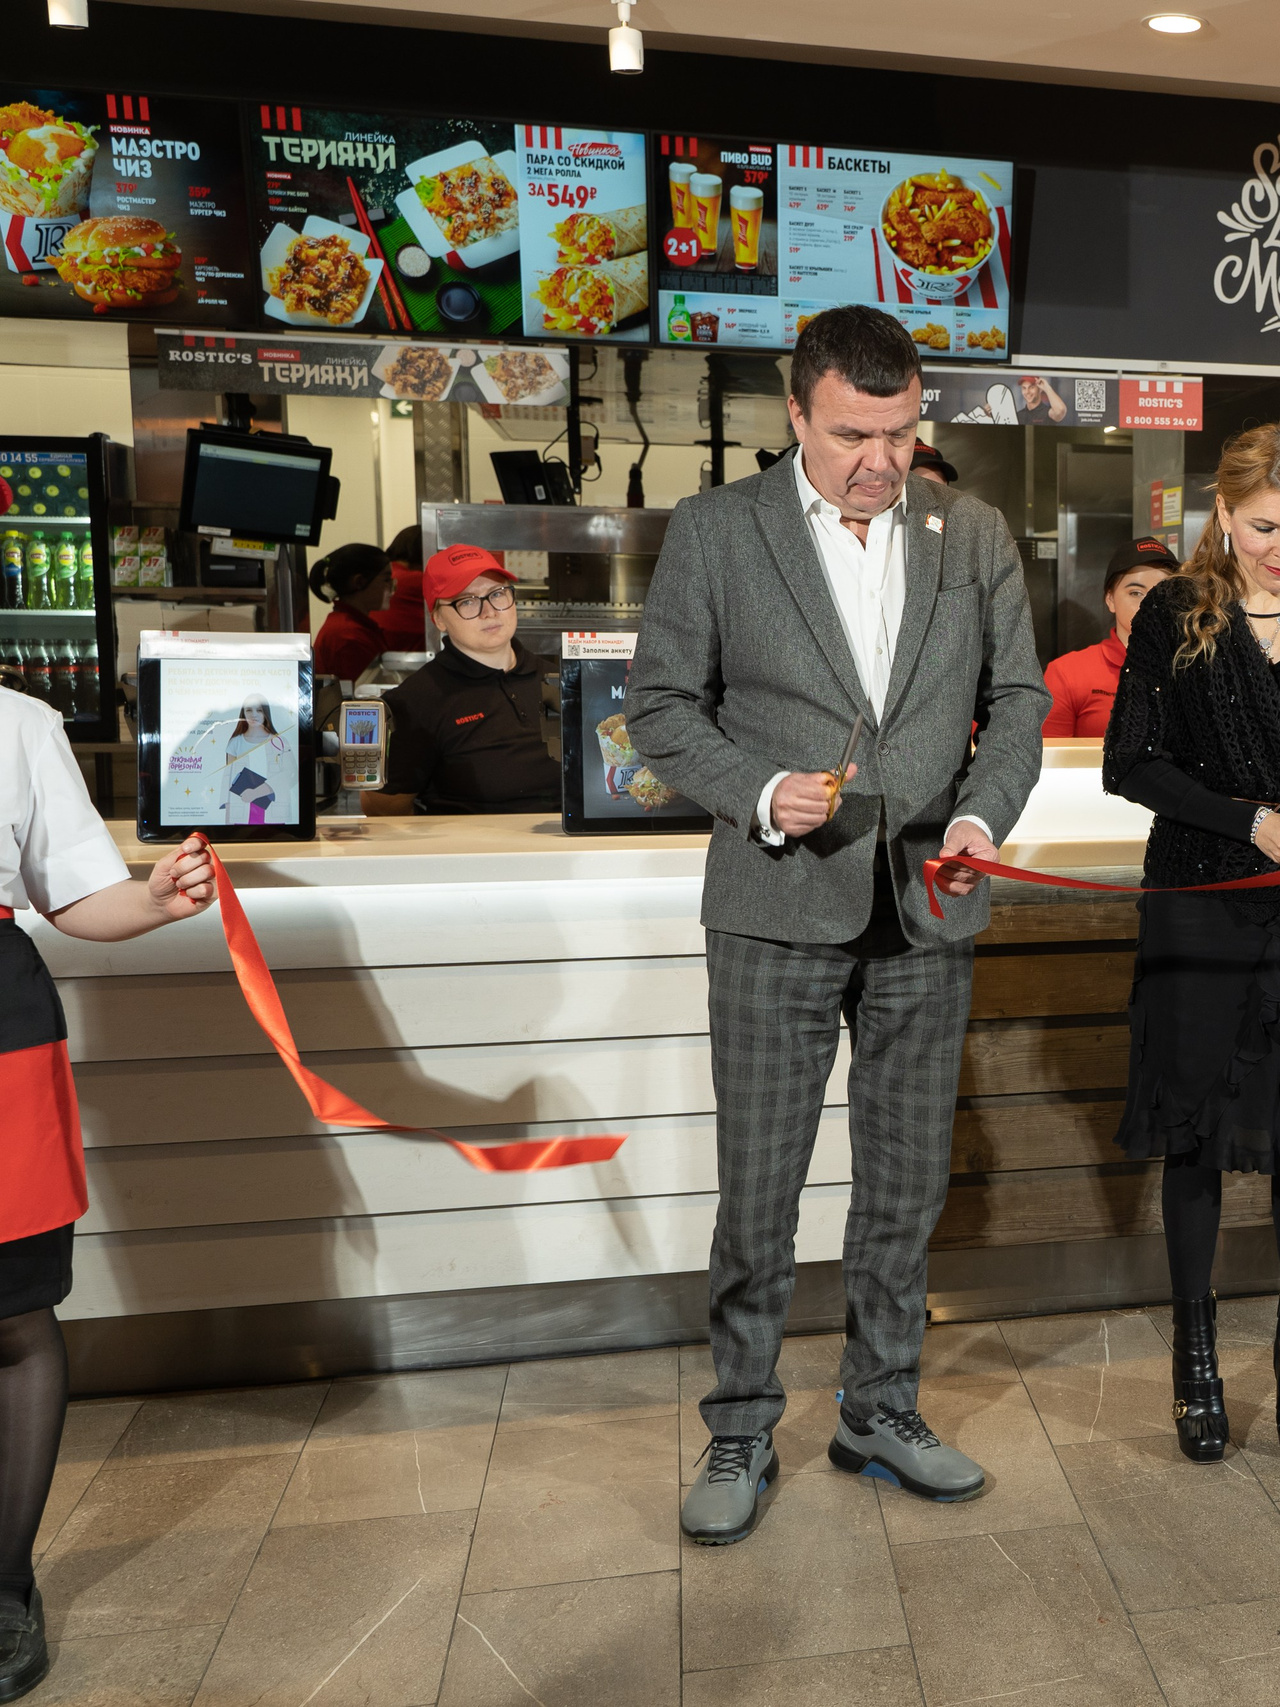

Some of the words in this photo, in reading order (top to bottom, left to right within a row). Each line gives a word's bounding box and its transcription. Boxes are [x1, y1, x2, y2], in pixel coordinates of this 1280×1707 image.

[110, 125, 151, 135] НОВИНКА
[344, 131, 396, 144] ЛИНЕЙКА
[111, 136, 201, 161] МАЭСТРО
[262, 135, 397, 174] ТЕРИЯКИ
[570, 142, 621, 156] Новинка
[526, 154, 554, 165] ПАРА
[557, 156, 571, 166] СО
[574, 156, 625, 170] СКИДКОЙ
[720, 151, 749, 165] ПИВО
[750, 153, 773, 166] BUD
[113, 158, 153, 179] ЧИЗ
[827, 156, 891, 175] БАСКЕТЫ
[527, 167, 532, 175] 2
[533, 167, 553, 176] МЕГА
[555, 169, 582, 178] РОЛЛА
[528, 183, 546, 196] ЗА
[190, 208, 213, 216] БУРГЕР
[667, 238, 699, 262] 2+1
[168, 350, 253, 364] ROSTIC'S
[325, 357, 368, 366] ЛИНЕЙКА
[258, 361, 369, 391] ТЕРИЯКИ
[1125, 416, 1132, 424] 8
[1133, 416, 1152, 425] 800
[1154, 417, 1170, 425] 555
[1172, 418, 1184, 426] 24
[1186, 418, 1198, 426] 07
[10, 453, 22, 462] 14
[25, 453, 38, 463] 55
[146, 557, 160, 568] J7
[455, 712, 484, 725] ROSTIC'S
